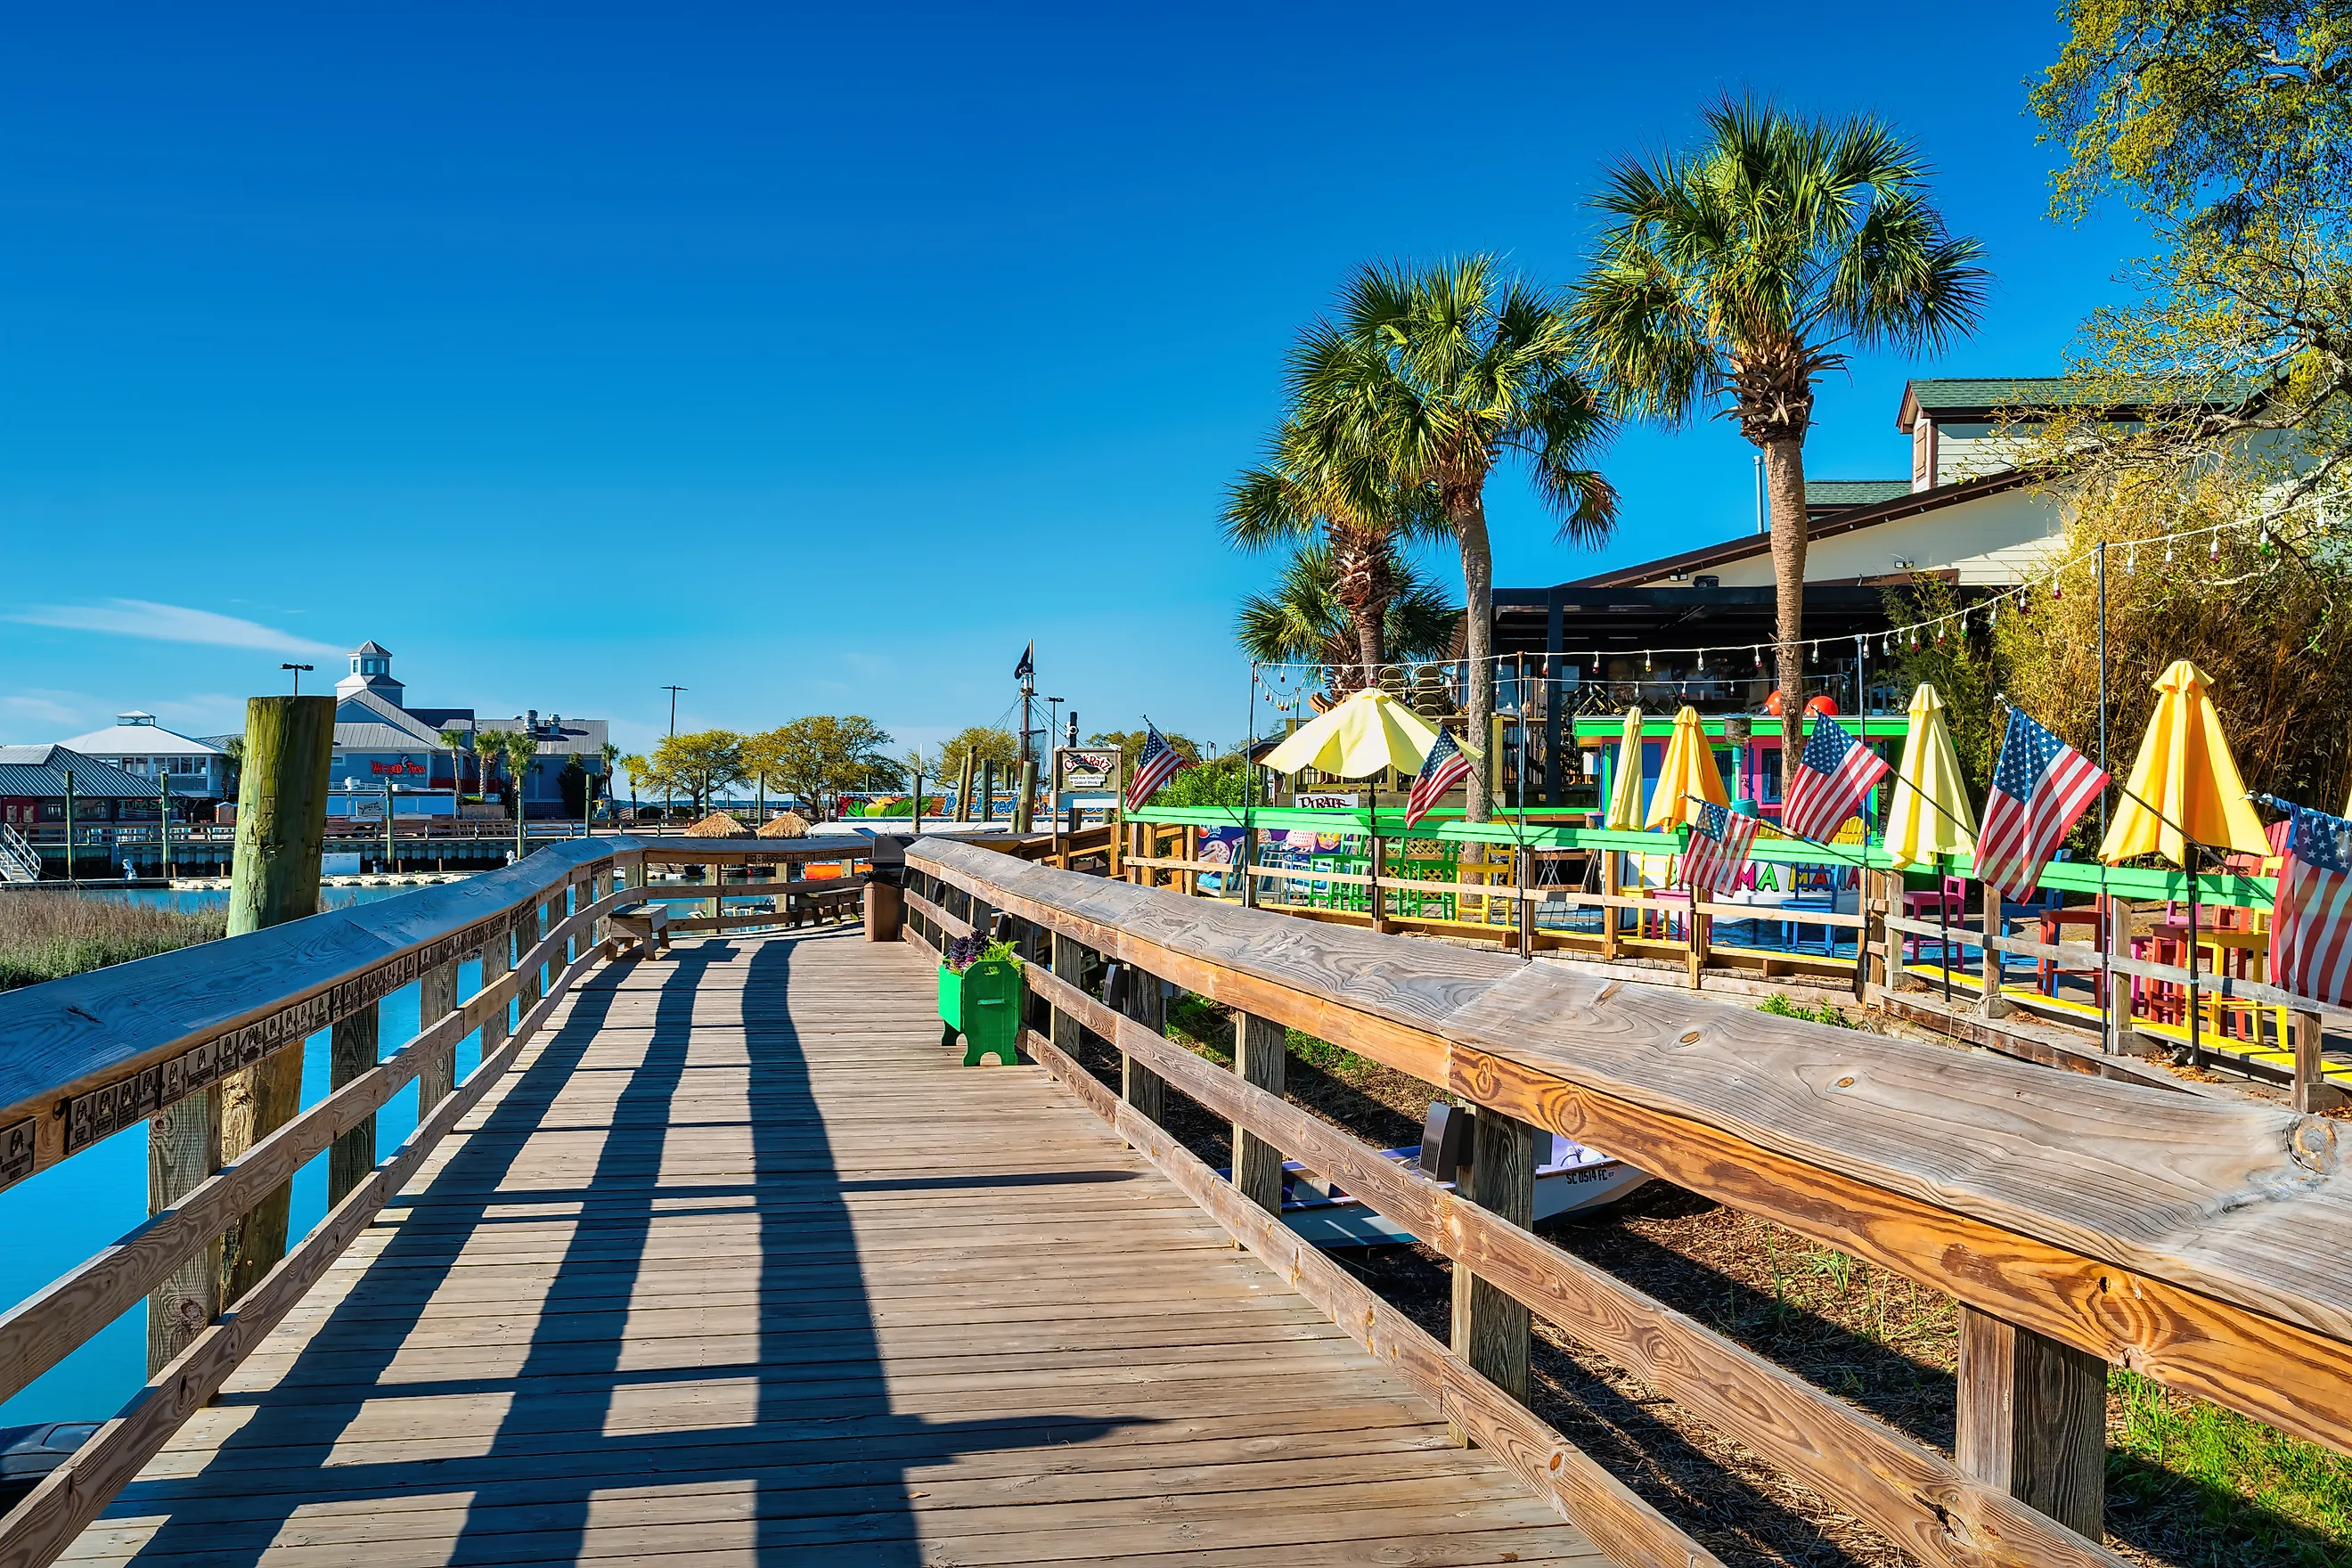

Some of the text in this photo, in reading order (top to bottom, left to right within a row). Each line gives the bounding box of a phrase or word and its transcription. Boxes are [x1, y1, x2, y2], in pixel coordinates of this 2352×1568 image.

[1565, 1172, 1577, 1184] SC
[1579, 1169, 1597, 1183] 0514
[1597, 1169, 1608, 1181] FC
